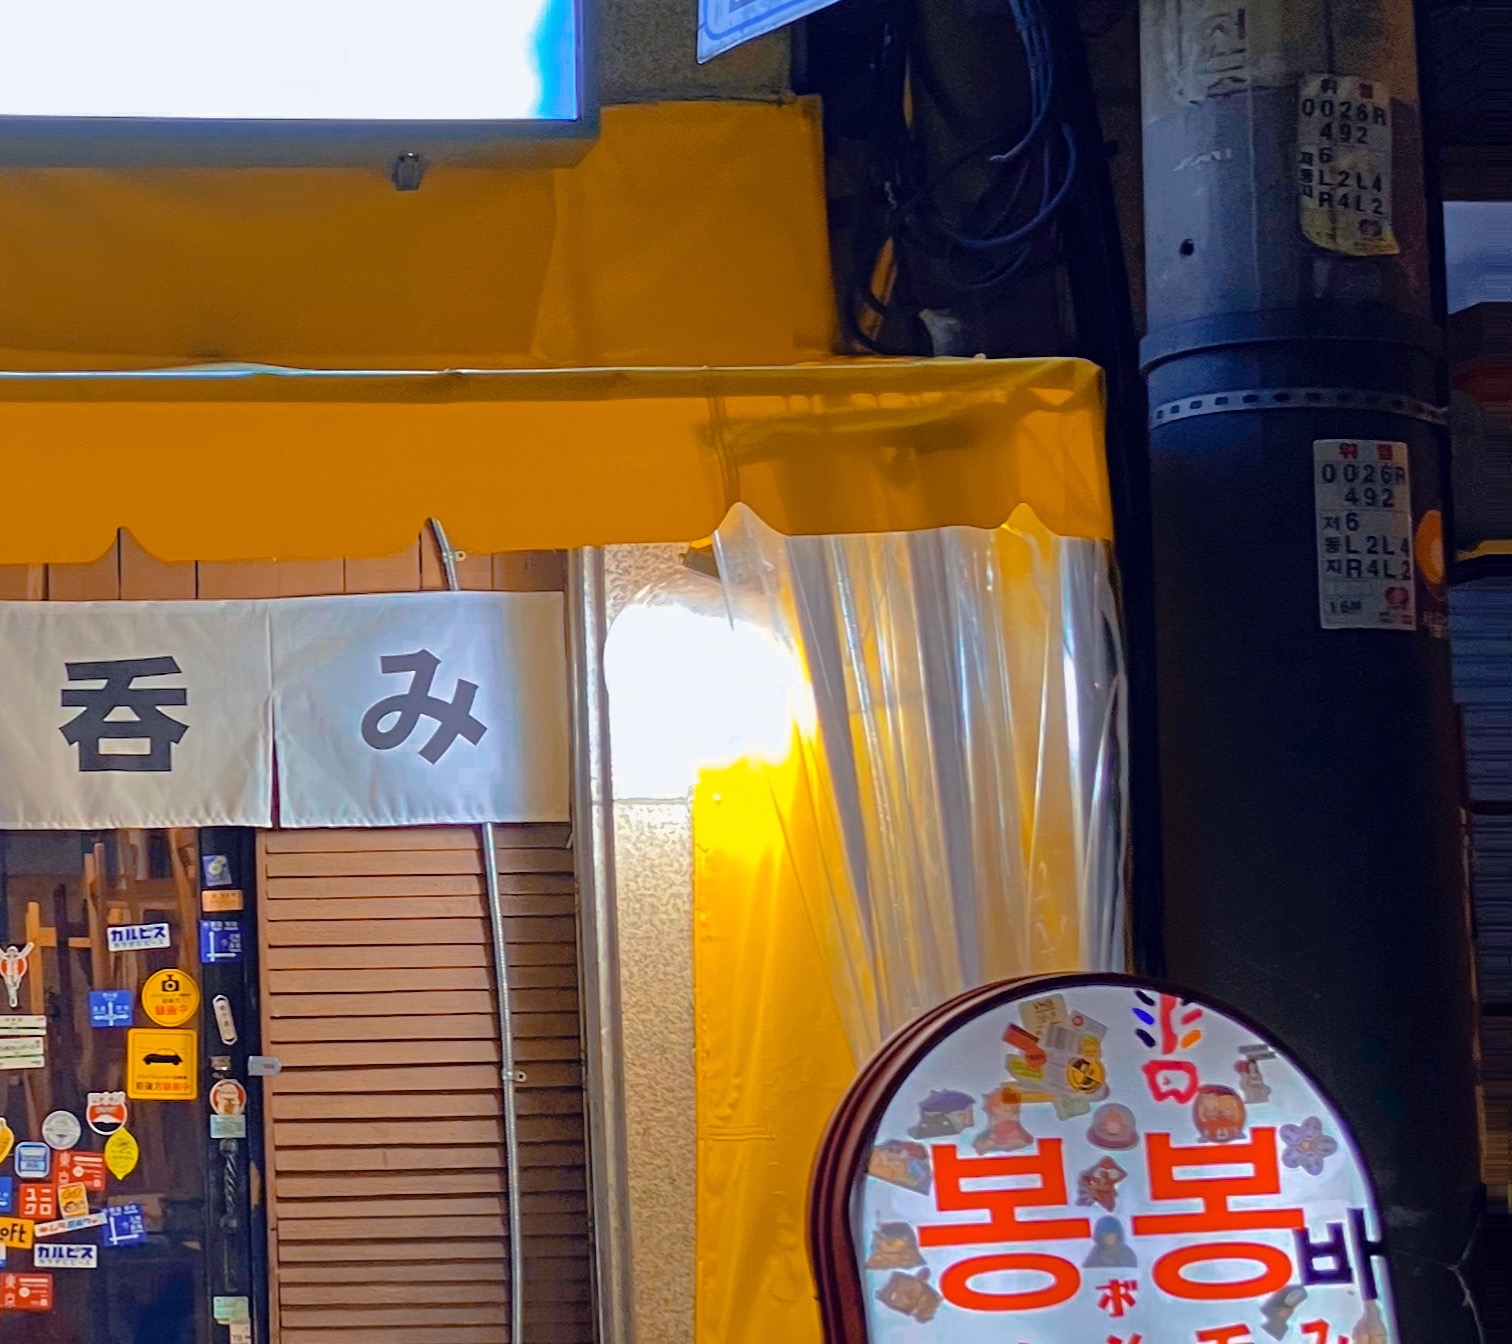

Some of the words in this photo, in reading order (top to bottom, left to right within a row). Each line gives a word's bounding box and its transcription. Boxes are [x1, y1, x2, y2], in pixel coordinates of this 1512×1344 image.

[1319, 122, 1369, 144] 492
[1344, 487, 1395, 508] 492
[1345, 512, 1360, 532] 6
[38, 1246, 93, 1259] カルピス
